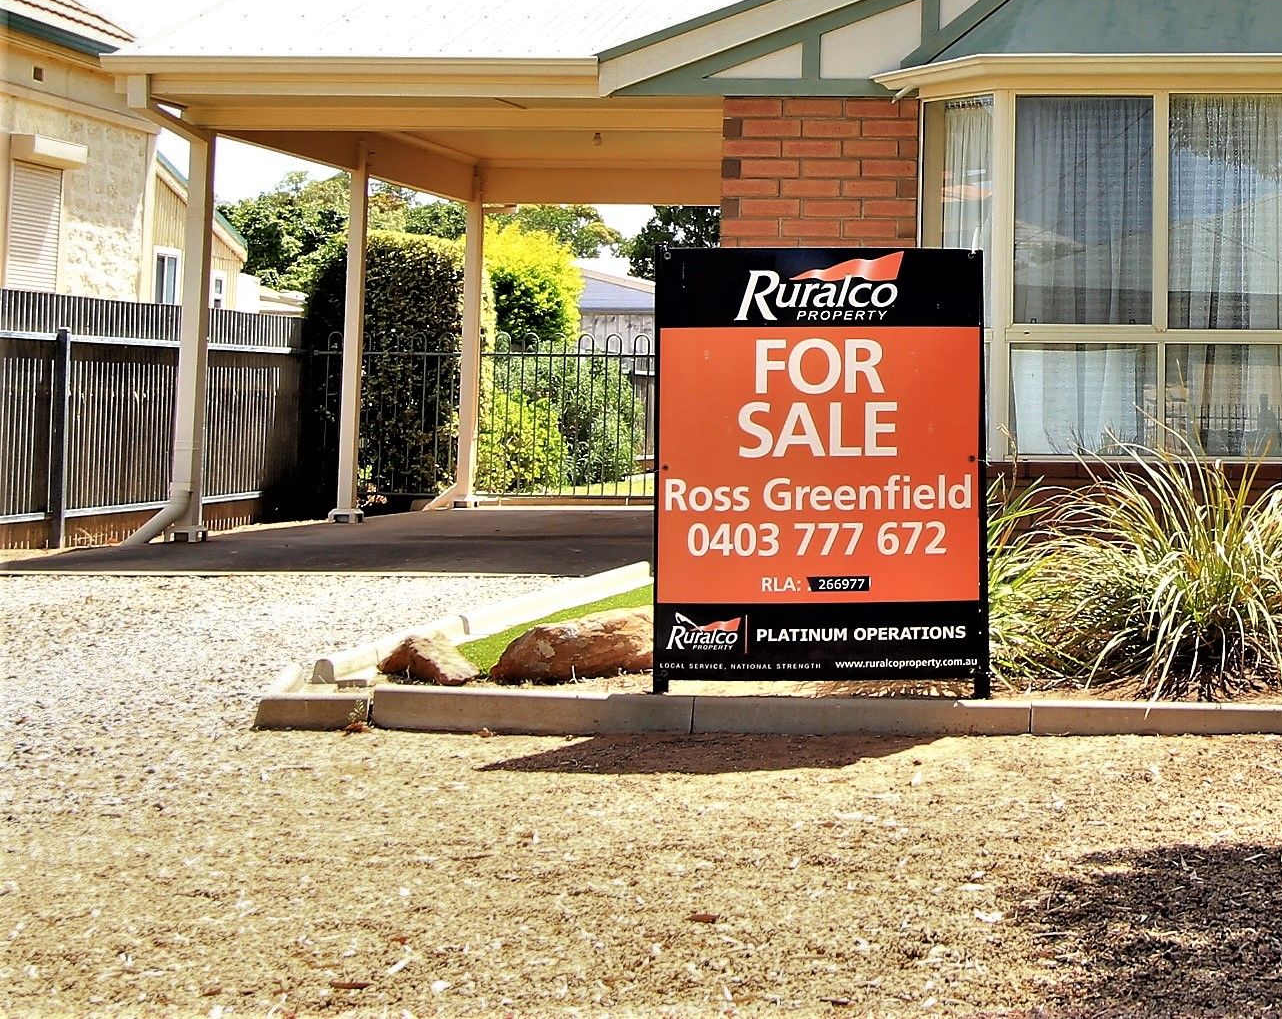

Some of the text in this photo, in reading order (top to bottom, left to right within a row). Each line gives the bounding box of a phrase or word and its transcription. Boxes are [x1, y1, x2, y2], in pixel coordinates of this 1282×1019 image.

[733, 270, 898, 321] Ruralco
[796, 310, 888, 321] PROPERTY
[755, 338, 886, 394] FOR
[737, 401, 898, 458] SALE
[664, 474, 972, 512] Ross Greenfield
[687, 521, 947, 557] 0403 777 672
[761, 576, 865, 592] RLA: 266977
[665, 625, 738, 650] Ruralco
[756, 625, 967, 642] PLATINUM OPERATIONS
[835, 658, 978, 669] www.ruralcoproperty.com.au
